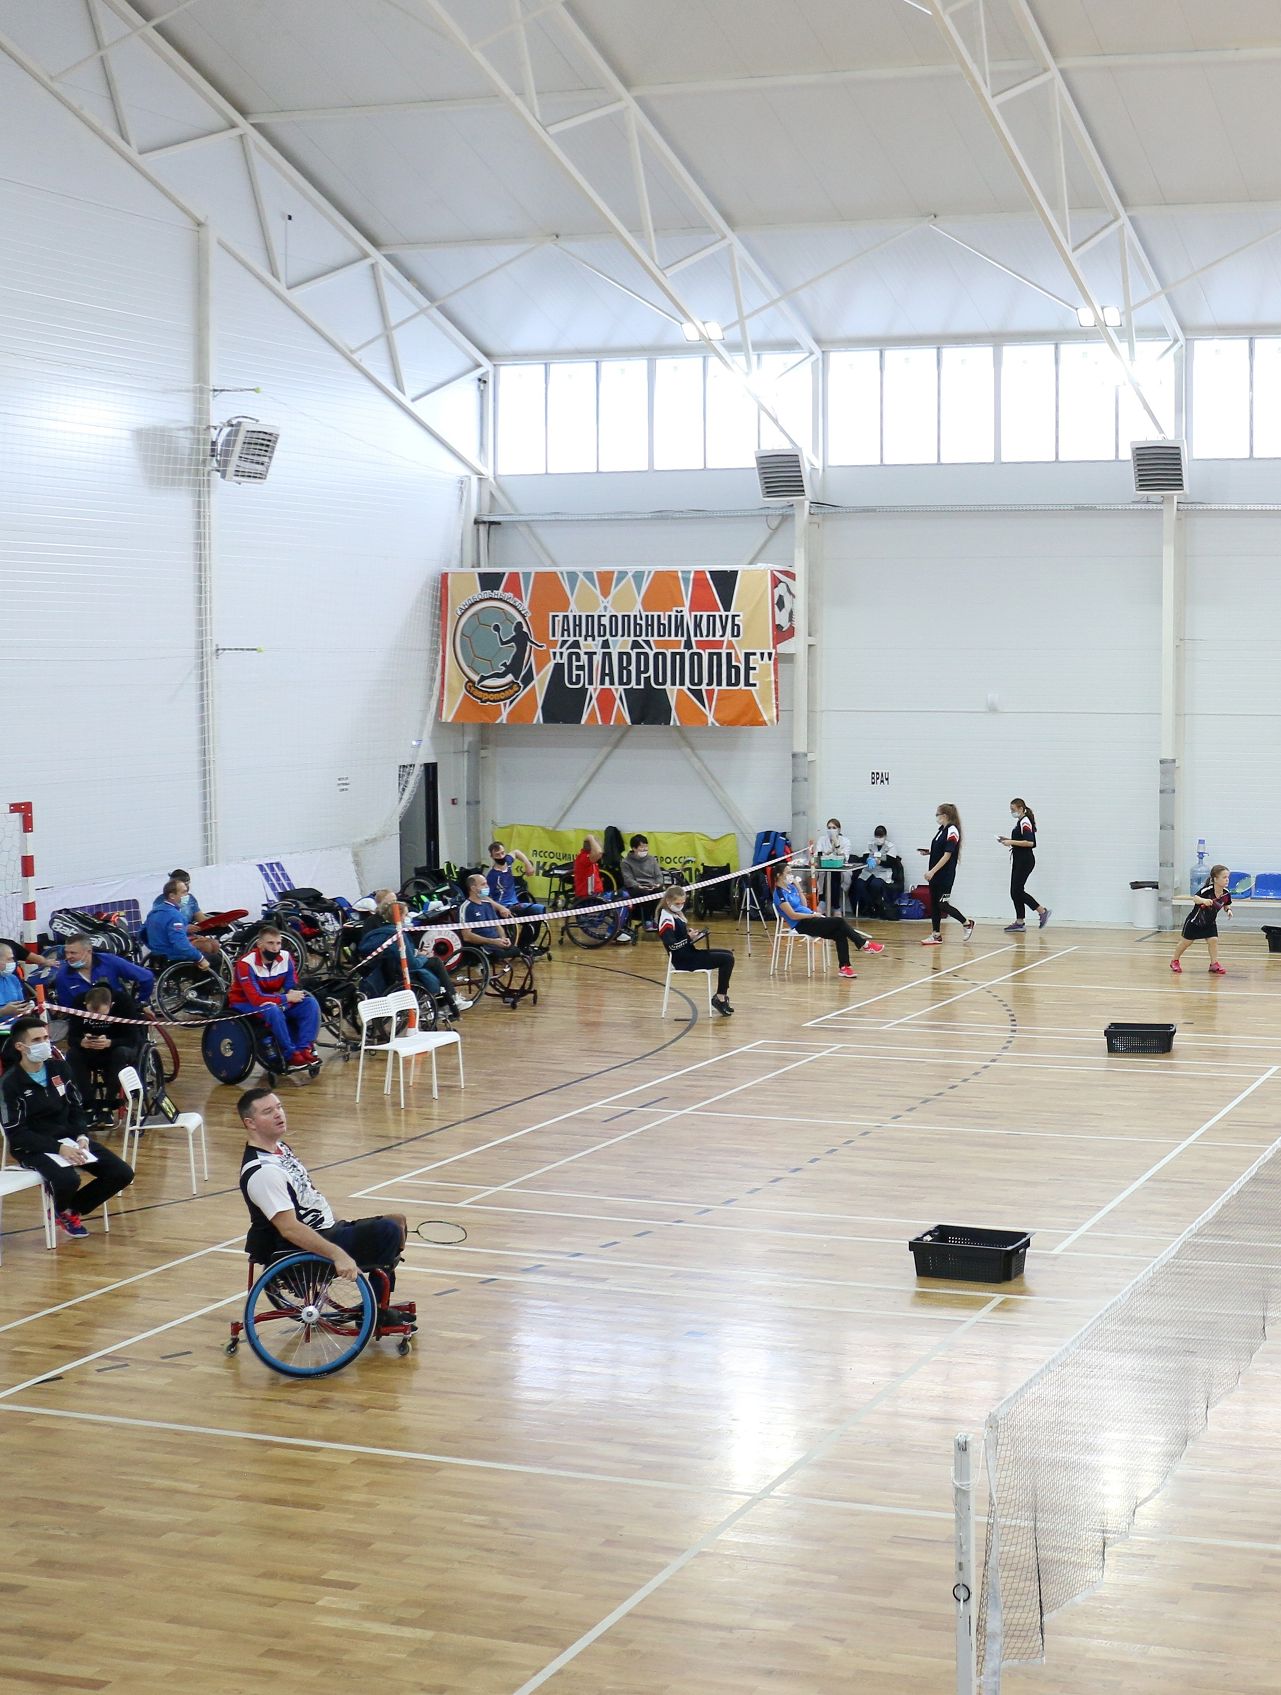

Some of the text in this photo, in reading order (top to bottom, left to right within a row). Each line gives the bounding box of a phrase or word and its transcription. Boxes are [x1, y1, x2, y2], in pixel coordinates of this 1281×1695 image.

[550, 610, 742, 641] ГАНДБОЛЬНЫЙ КЛУБ
[551, 651, 774, 688] "СТАВРОПОЛЬЕ"
[870, 771, 890, 786] ВРАЧ
